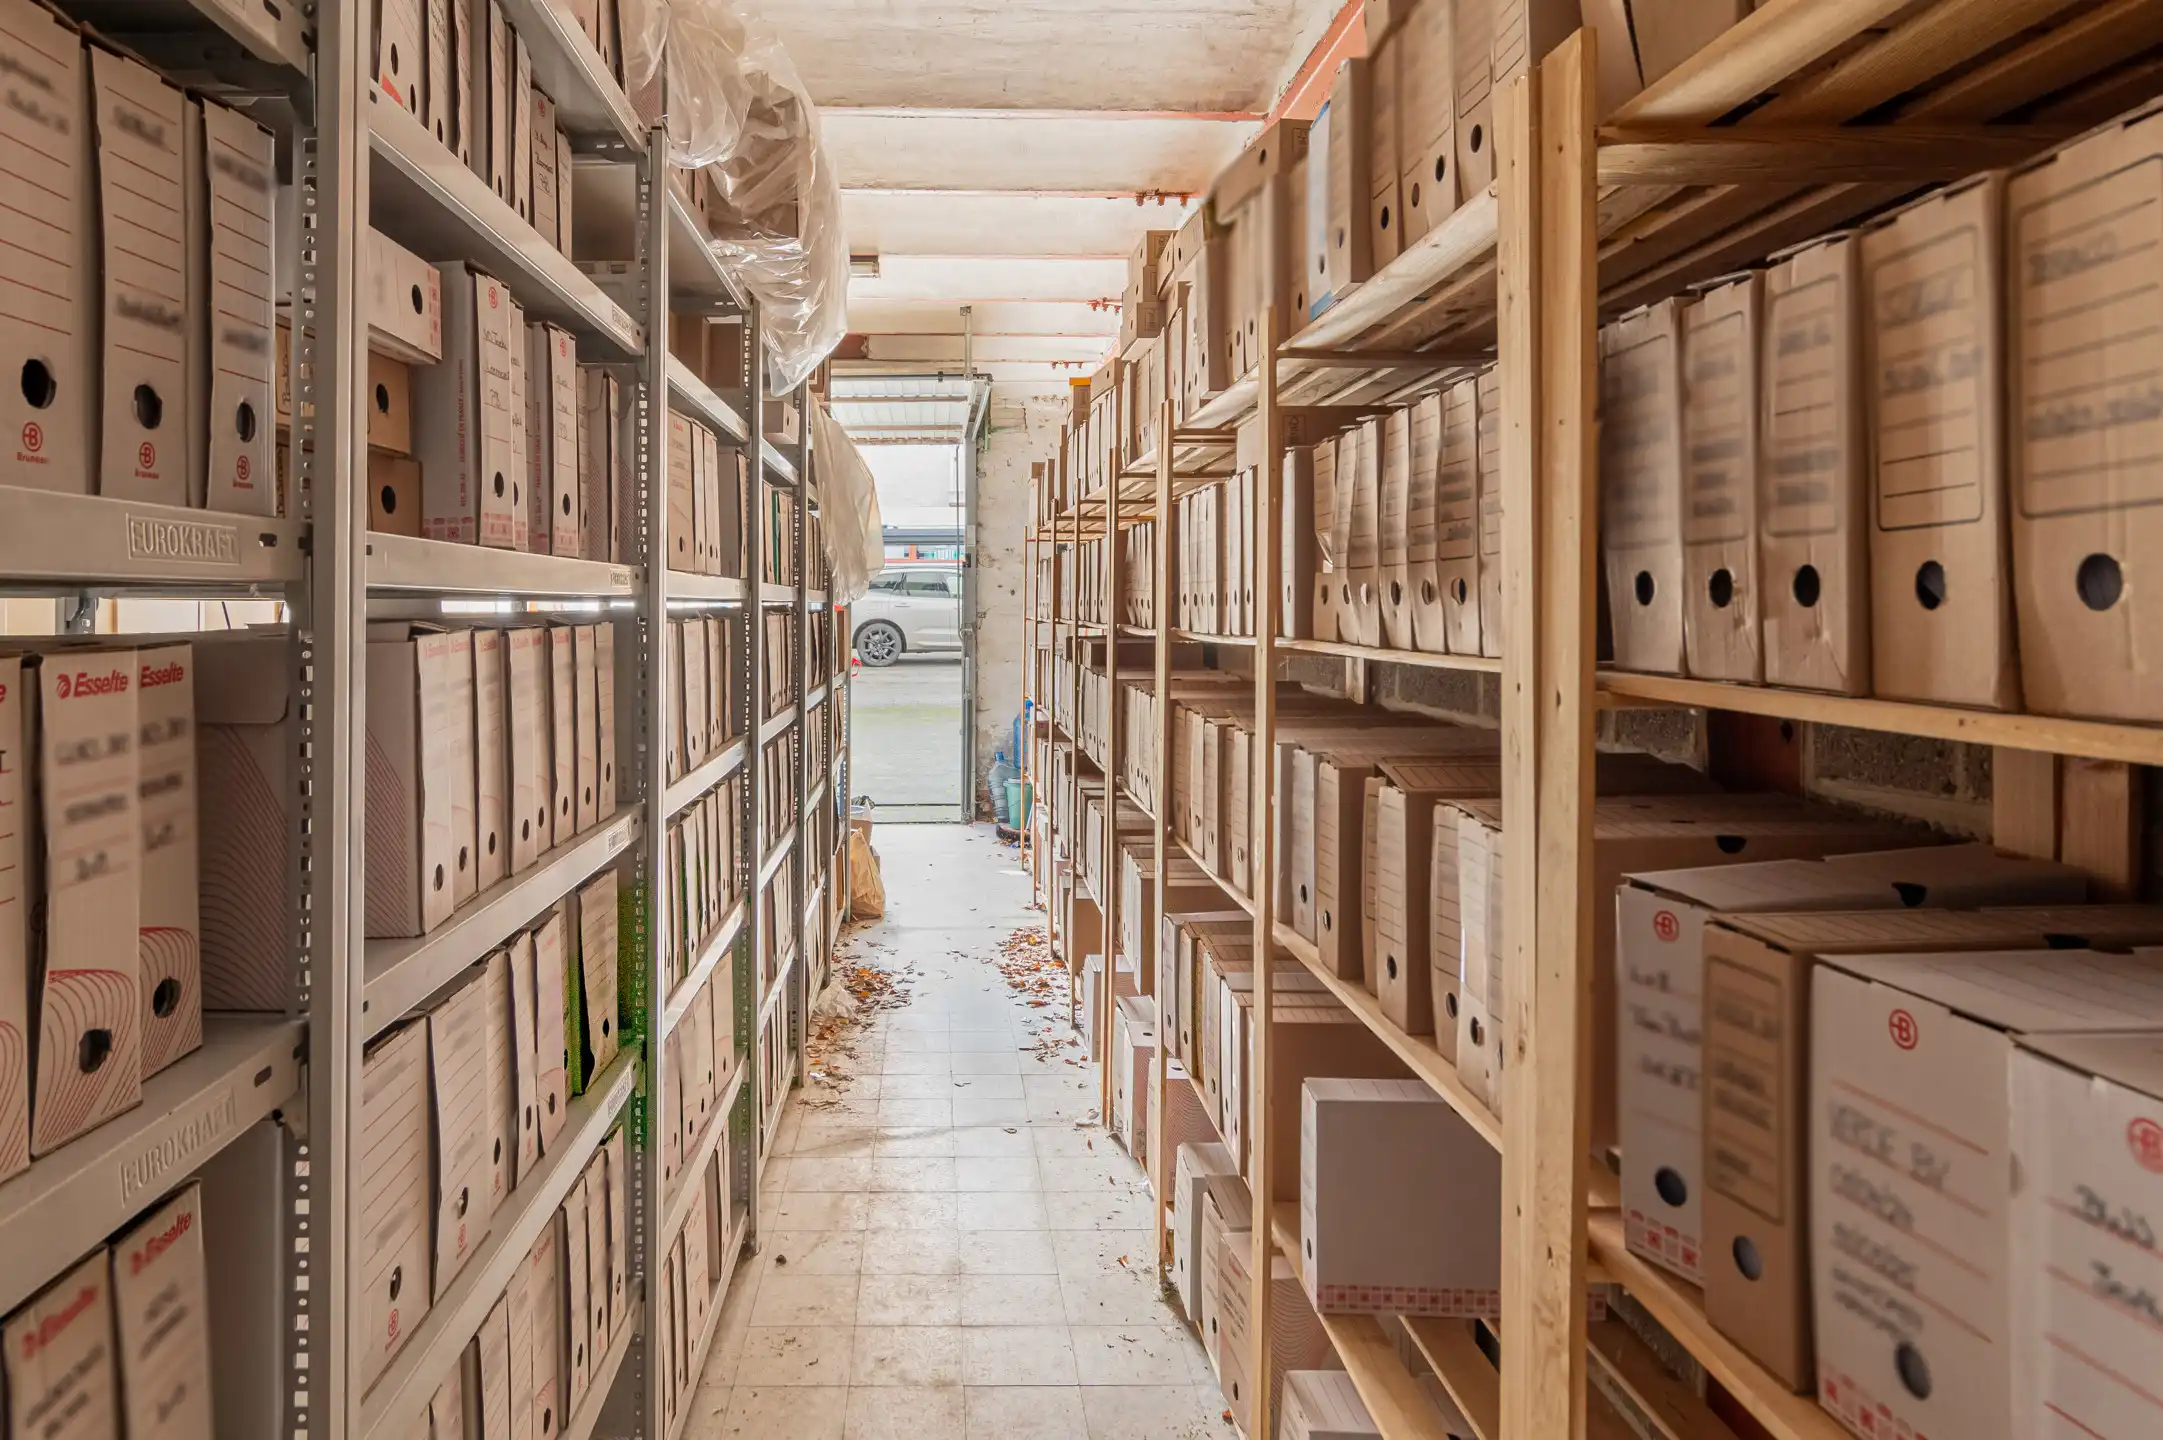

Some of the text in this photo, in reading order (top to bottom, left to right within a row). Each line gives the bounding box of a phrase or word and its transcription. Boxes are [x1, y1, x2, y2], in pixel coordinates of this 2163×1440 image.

[130, 520, 236, 559] EUROKRAFT
[73, 669, 129, 698] Esselte
[140, 661, 185, 689] Esselte
[124, 1094, 230, 1199] EUROKRAFT
